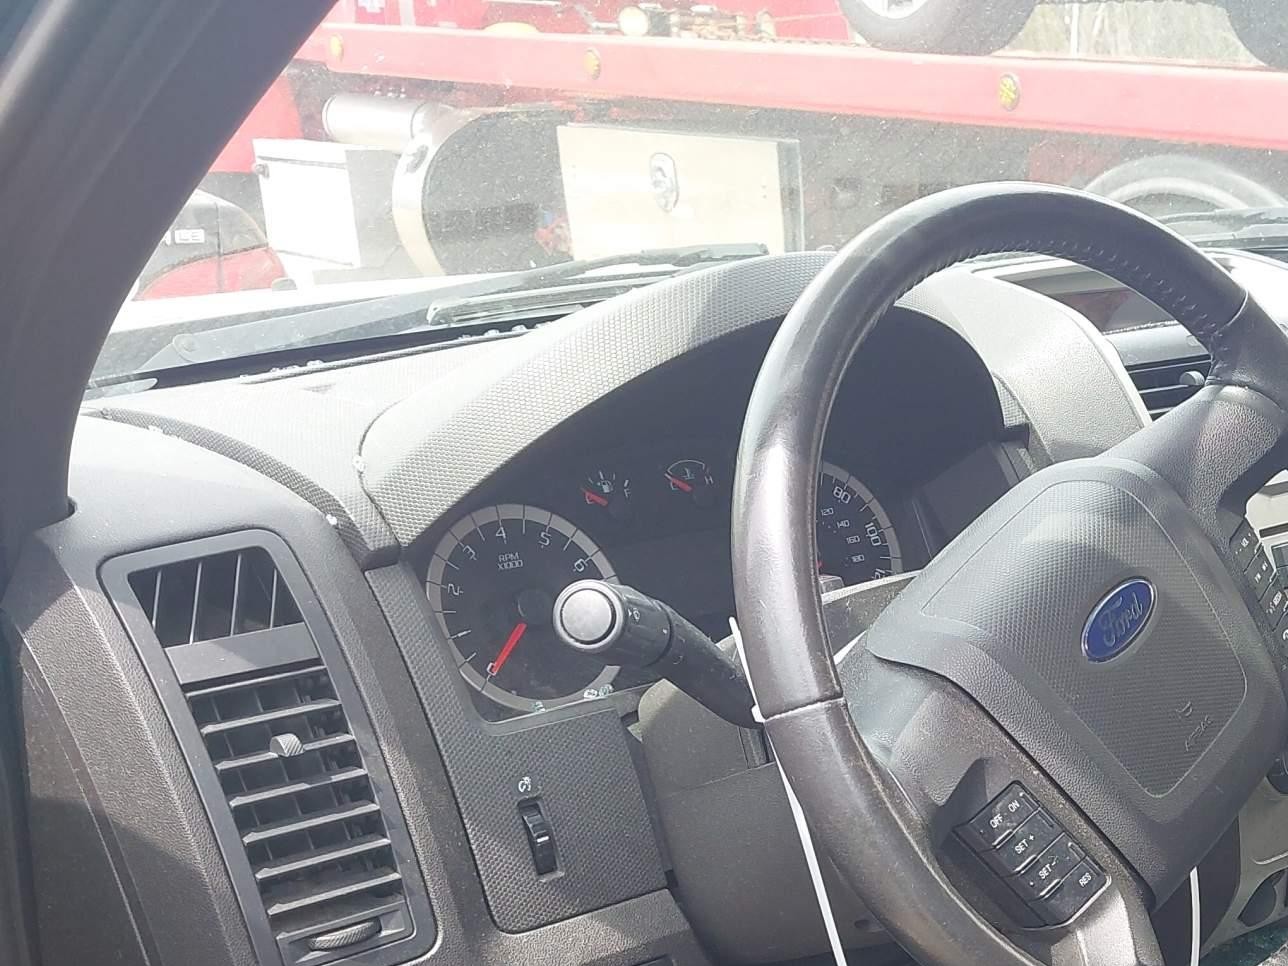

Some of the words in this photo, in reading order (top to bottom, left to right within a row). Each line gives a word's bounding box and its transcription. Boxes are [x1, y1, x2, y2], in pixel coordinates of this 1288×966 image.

[833, 487, 851, 503] 80
[837, 519, 850, 528] 140
[495, 526, 507, 540] 4
[539, 531, 551, 546] 5
[864, 522, 881, 546] 100
[462, 545, 476, 559] 3
[498, 552, 520, 563] RPM
[576, 559, 586, 572] 6
[447, 583, 461, 596] 2
[1101, 592, 1144, 647] Ford
[990, 814, 1003, 828] OFF
[1008, 800, 1020, 812] ON
[1015, 839, 1028, 853] SET
[1039, 864, 1052, 879] SET
[1079, 873, 1092, 887] RES
